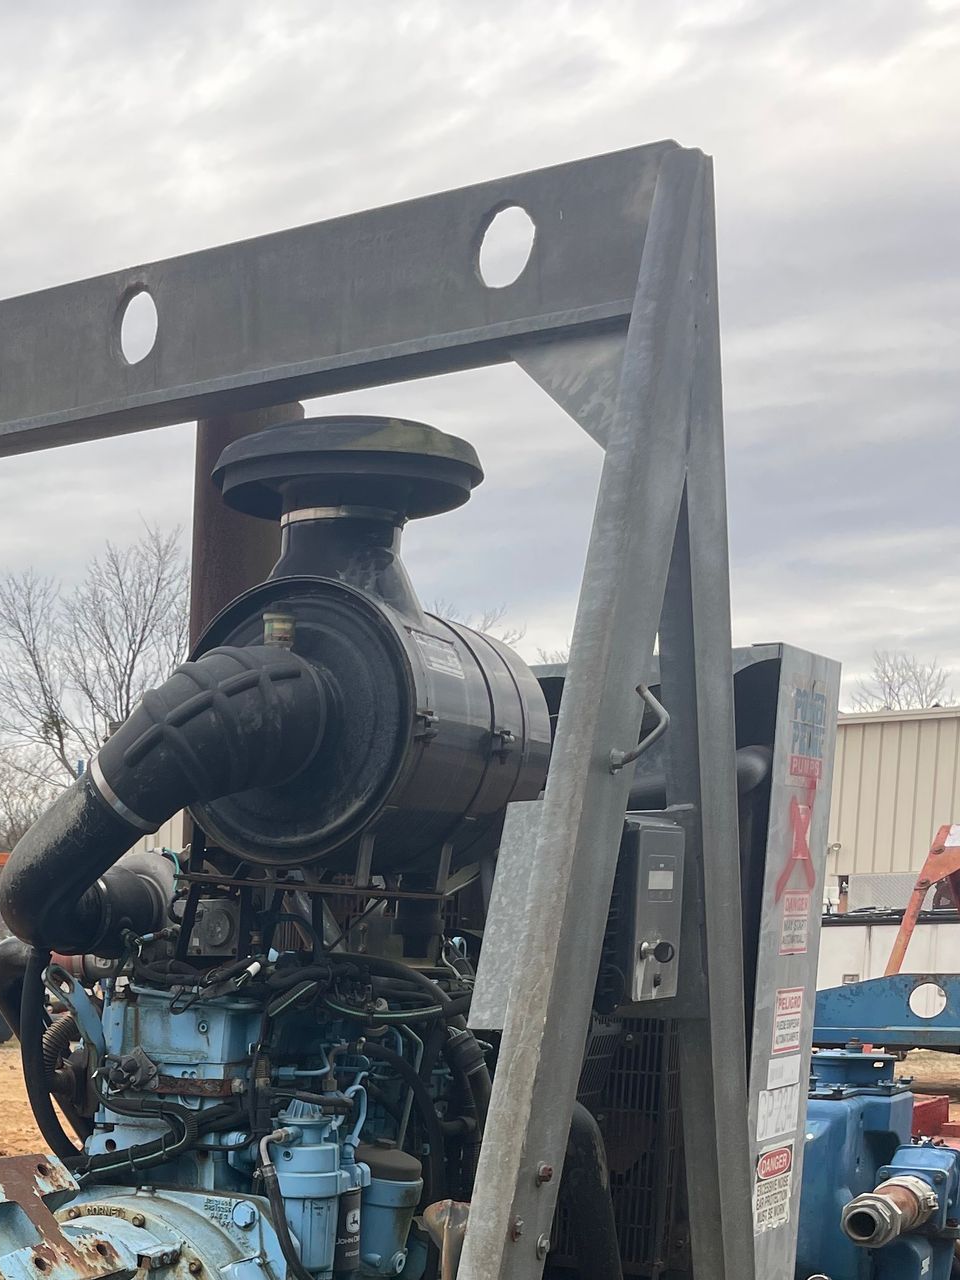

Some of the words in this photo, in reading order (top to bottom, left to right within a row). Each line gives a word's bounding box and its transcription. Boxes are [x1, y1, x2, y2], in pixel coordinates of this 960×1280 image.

[792, 757, 820, 777] PUMPS
[785, 897, 808, 912] DANGER
[778, 995, 800, 1010] PELIGRO
[761, 1153, 788, 1175] DANGER
[757, 1179, 778, 1197] EXCESSIVE
[336, 1235, 354, 1245] JOHN
